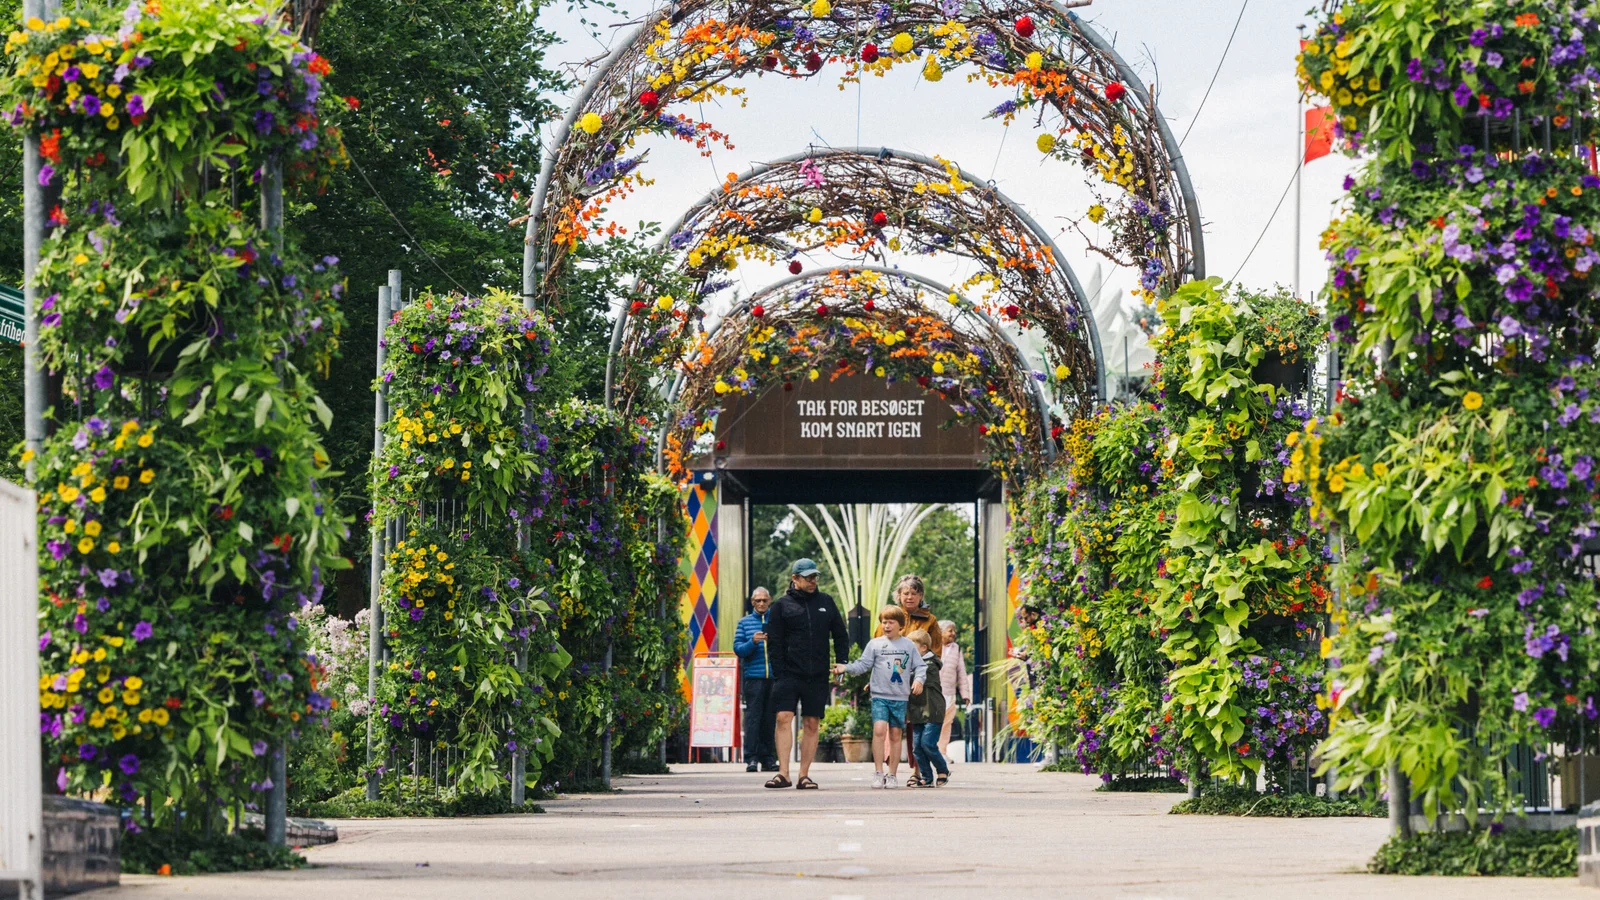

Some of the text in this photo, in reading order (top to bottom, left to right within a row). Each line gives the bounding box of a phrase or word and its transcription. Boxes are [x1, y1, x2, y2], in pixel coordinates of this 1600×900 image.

[797, 400, 925, 416] TAK FOR BESØGET
[800, 422, 922, 438] KOM SNART IGEN
